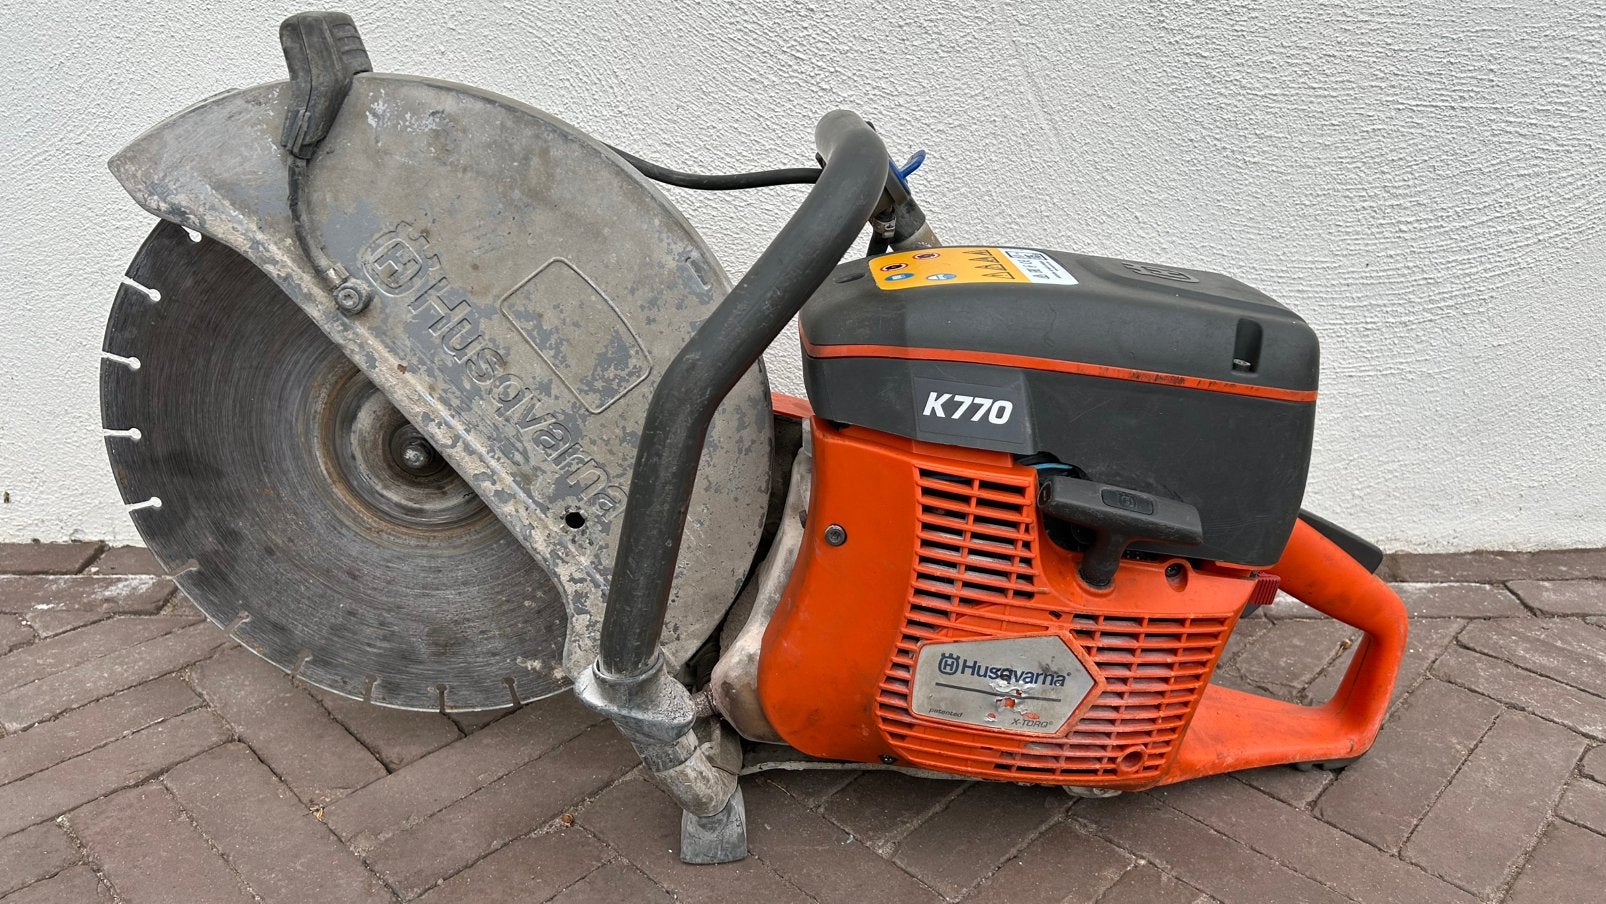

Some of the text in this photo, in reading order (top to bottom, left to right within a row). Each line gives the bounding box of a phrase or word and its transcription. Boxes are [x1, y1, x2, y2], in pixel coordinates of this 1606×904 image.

[408, 276, 628, 522] Husqvarna
[922, 391, 1013, 425] K770
[960, 658, 1067, 687] Husqvarna
[928, 708, 963, 718] patented
